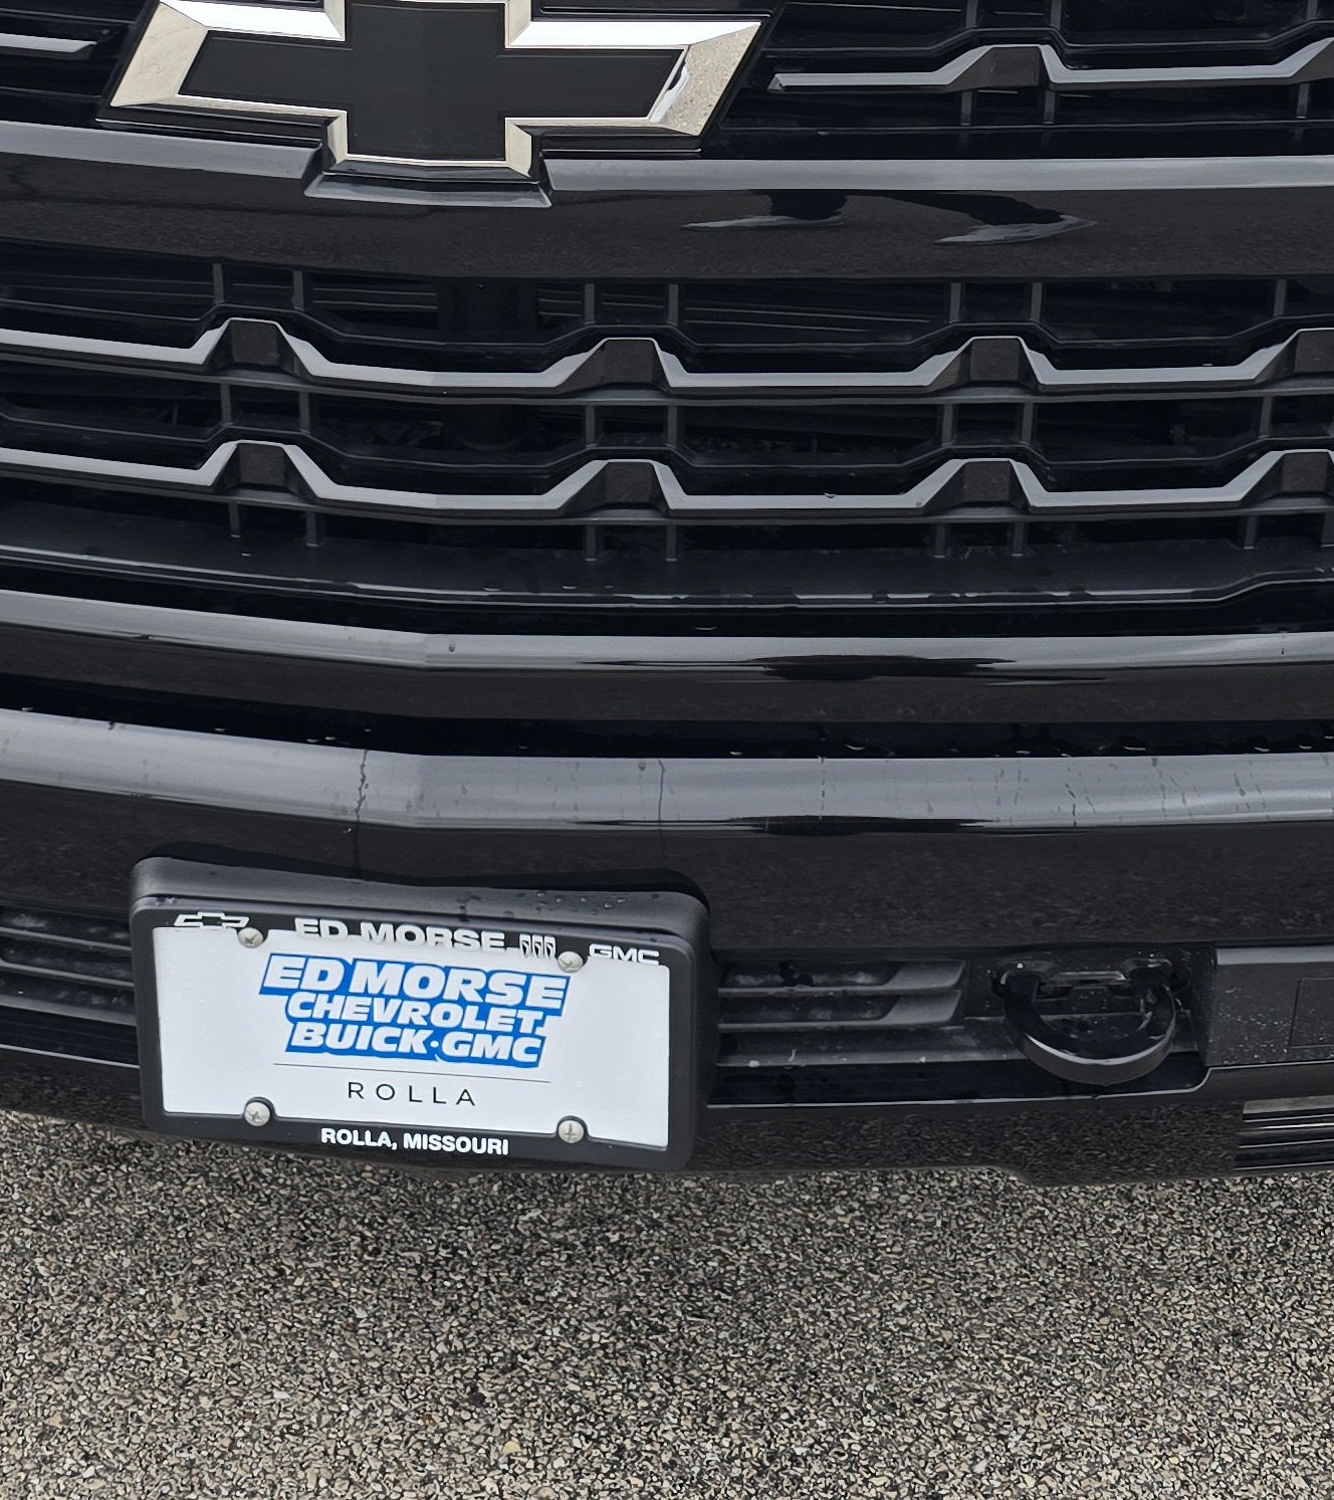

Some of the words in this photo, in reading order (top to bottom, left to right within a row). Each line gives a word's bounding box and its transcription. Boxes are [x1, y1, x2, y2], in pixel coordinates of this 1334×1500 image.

[295, 917, 349, 942] ED
[360, 921, 505, 952] MORSE
[589, 943, 660, 966] GMC
[263, 954, 345, 992] ED
[348, 960, 568, 1010] MORSE
[348, 1081, 476, 1107] ROLLA
[321, 1127, 398, 1151] ROLLA,
[403, 1132, 509, 1156] MISSOURI
